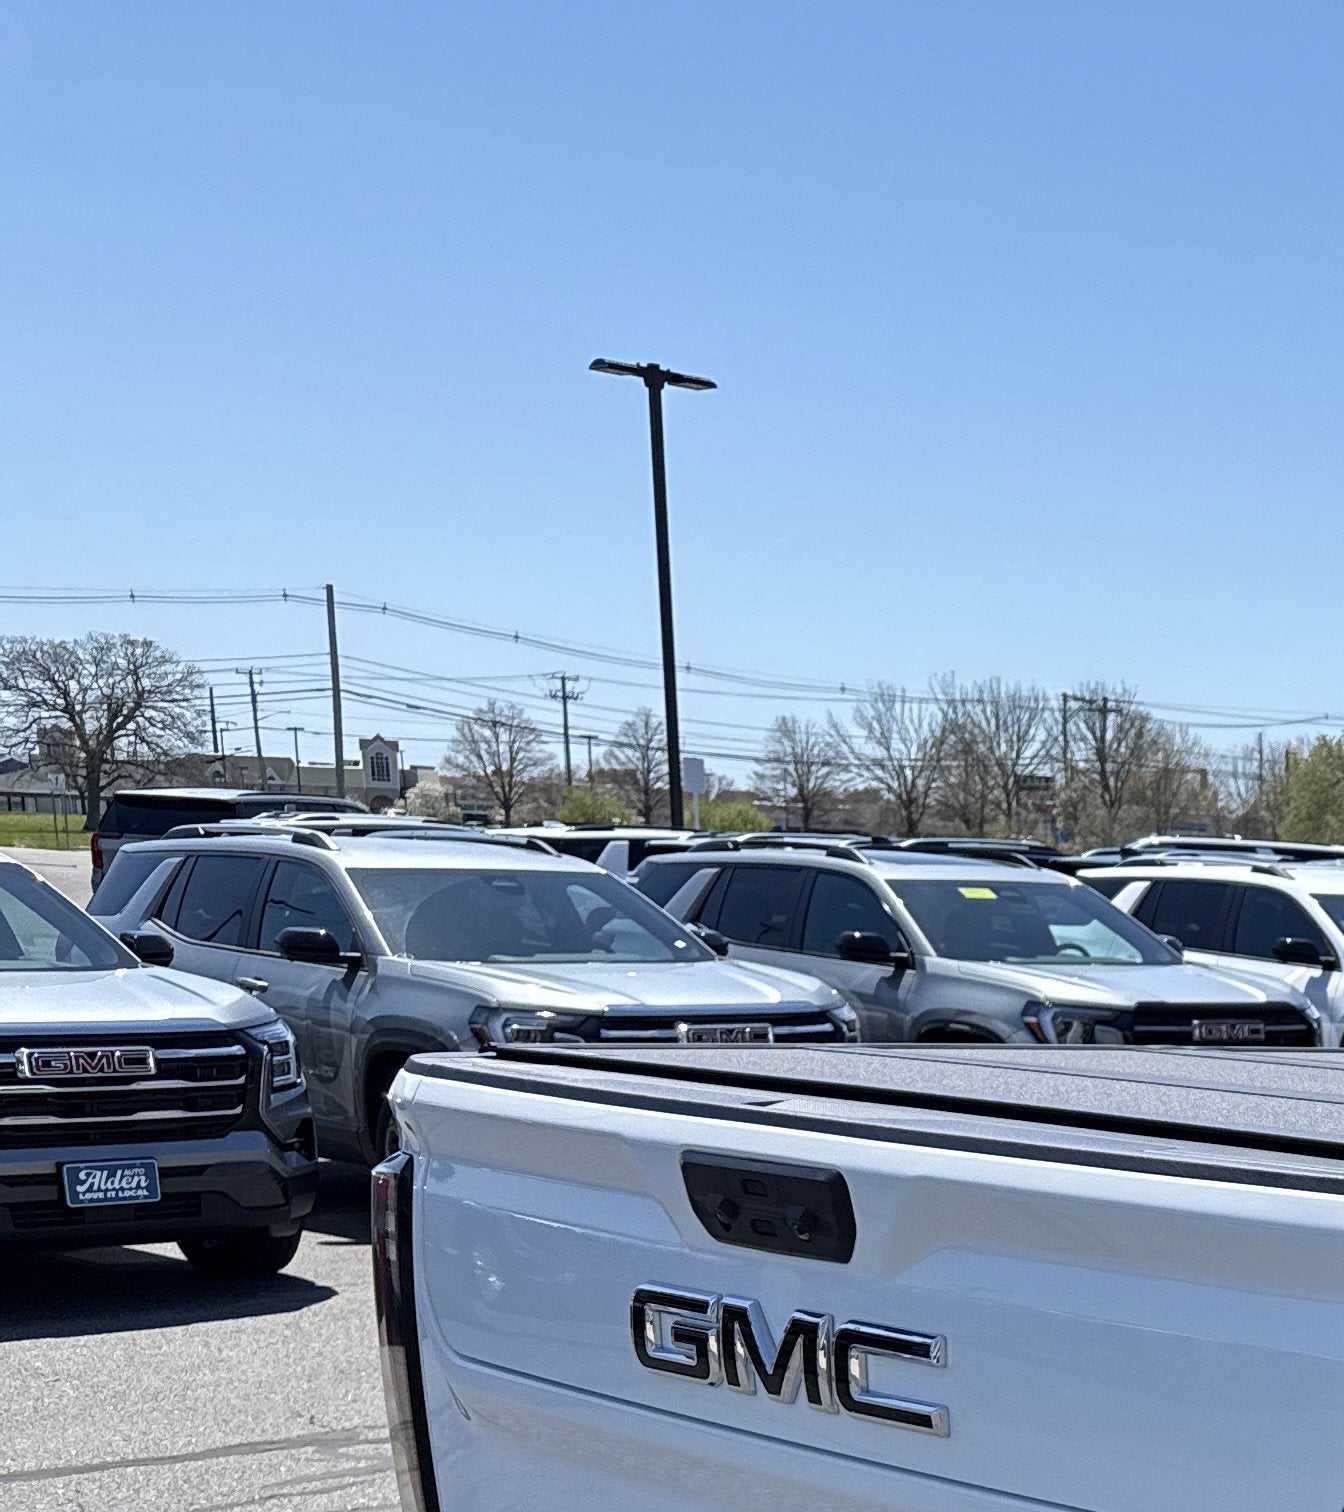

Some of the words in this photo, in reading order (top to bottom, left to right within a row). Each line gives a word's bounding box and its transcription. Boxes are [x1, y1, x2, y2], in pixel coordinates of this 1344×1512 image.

[31, 1051, 152, 1075] GMC
[76, 1169, 150, 1193] Alden
[123, 1167, 146, 1176] AUTO
[79, 1191, 105, 1200] LOVE
[106, 1190, 117, 1199] IT
[118, 1188, 150, 1198] LOCAL
[630, 1280, 950, 1438] GMC
